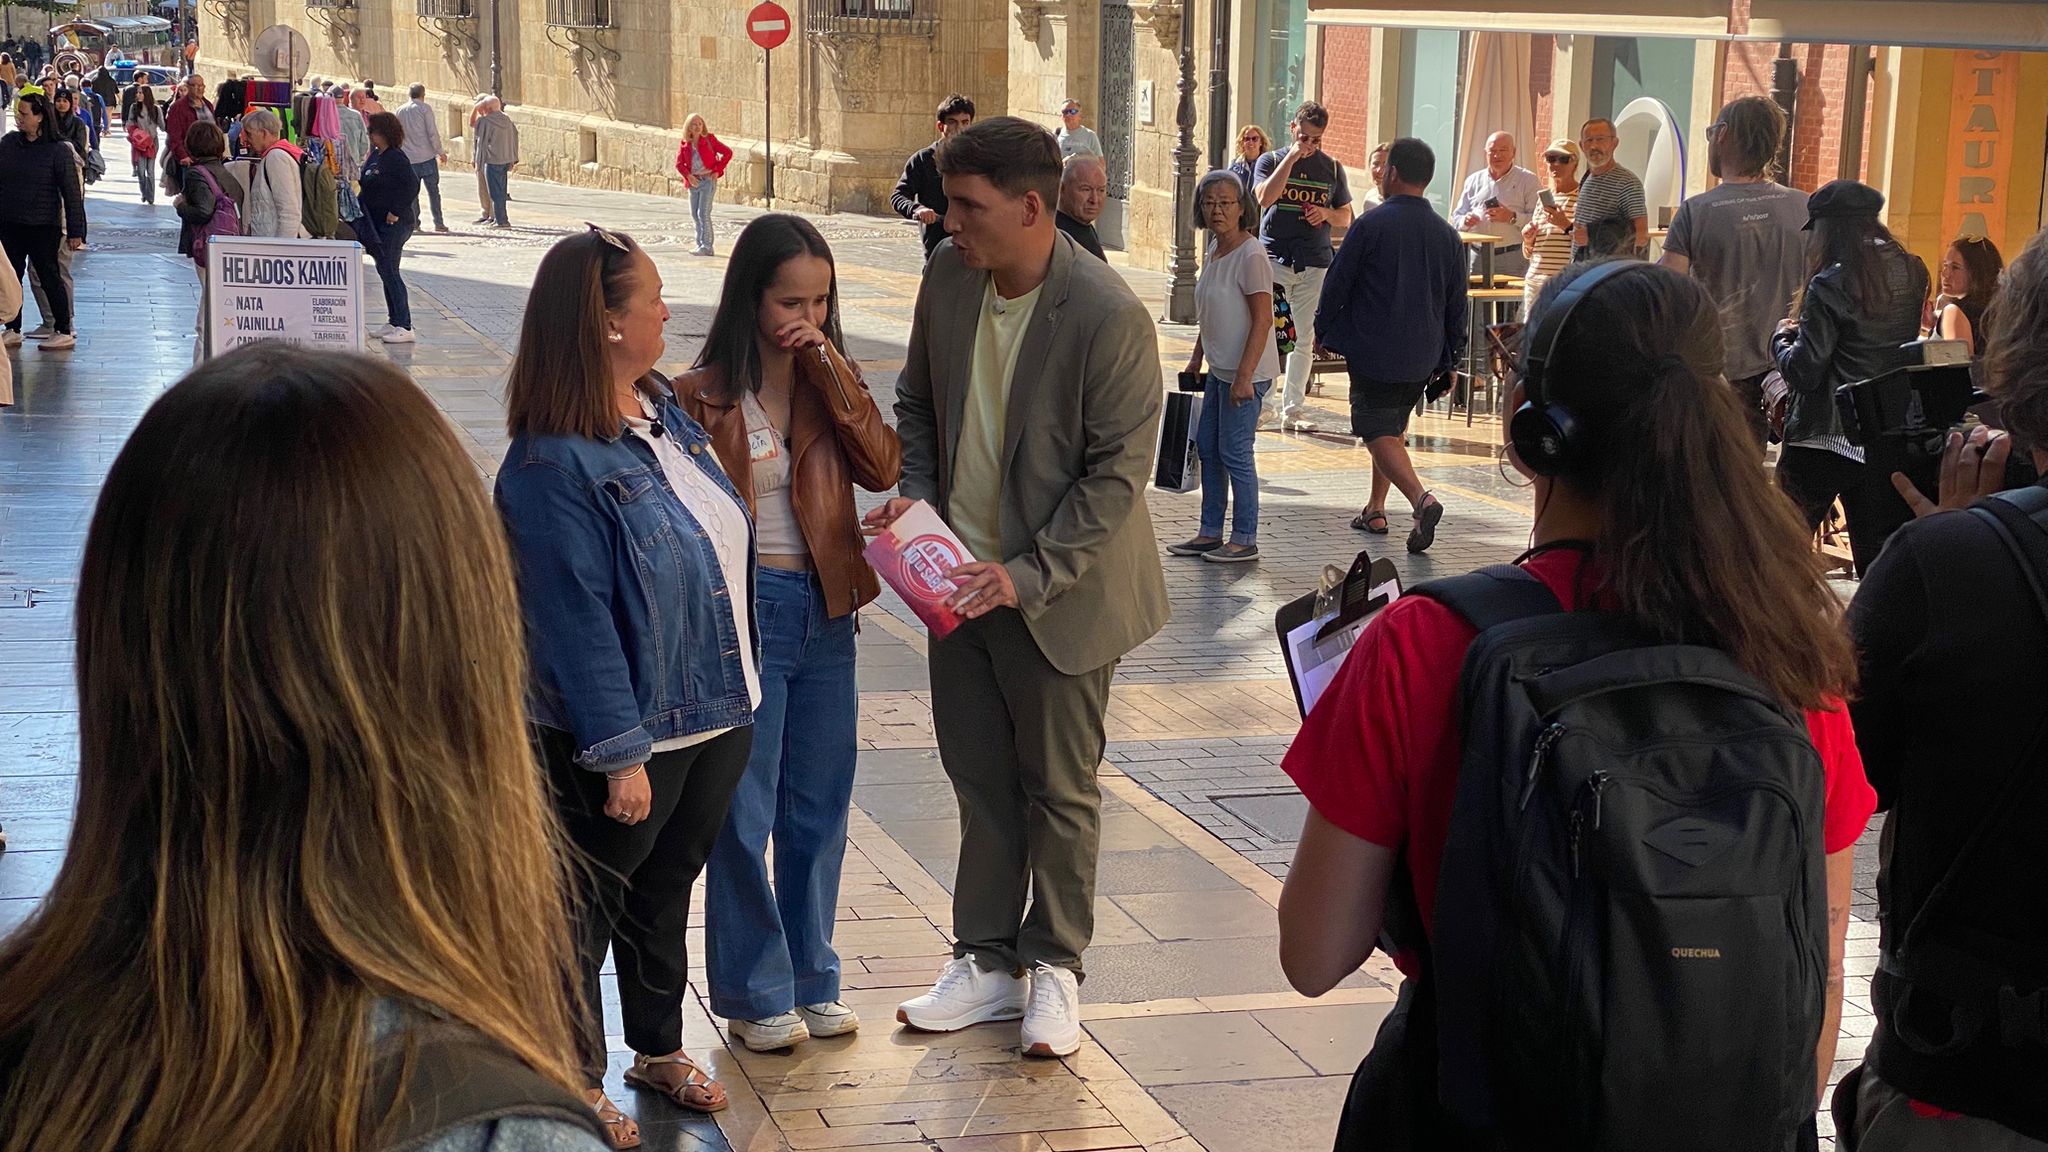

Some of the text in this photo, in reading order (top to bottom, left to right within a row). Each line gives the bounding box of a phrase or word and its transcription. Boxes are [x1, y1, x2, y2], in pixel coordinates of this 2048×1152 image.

[222, 256, 347, 286] HELADOS KAMÍN
[236, 296, 264, 311] NATA
[312, 298, 346, 307] ELABORACIÓN
[312, 306, 332, 315] PROPIA
[236, 316, 285, 331] VAINILLA
[313, 315, 347, 323] Y ARTESANA
[313, 332, 346, 340] TARRINA
[923, 542, 938, 557] LO
[1671, 947, 1720, 958] QUECHUA
